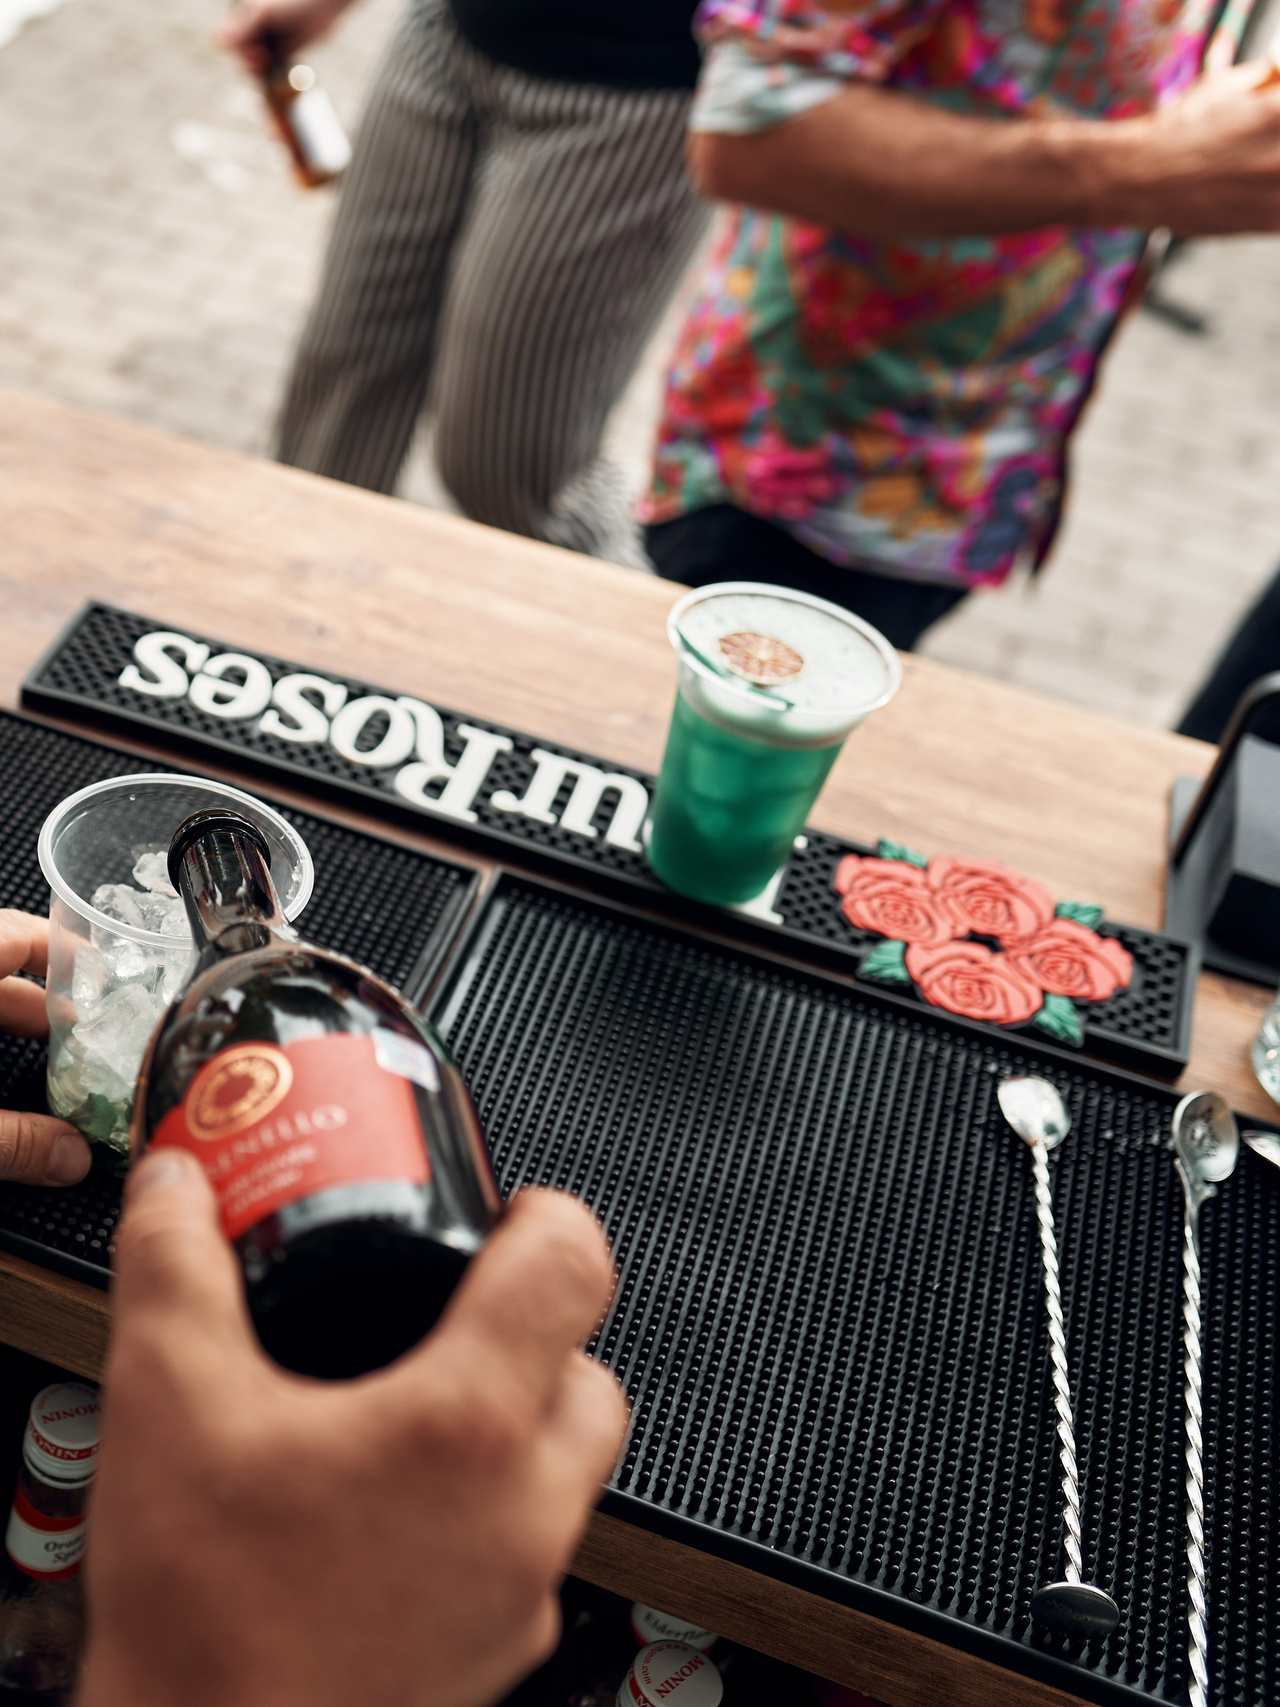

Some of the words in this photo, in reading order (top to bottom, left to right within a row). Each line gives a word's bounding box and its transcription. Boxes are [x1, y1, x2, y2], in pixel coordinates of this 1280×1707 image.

[120, 631, 512, 823] Roses
[41, 1403, 101, 1424] MONIN
[655, 1655, 705, 1699] MONIN
